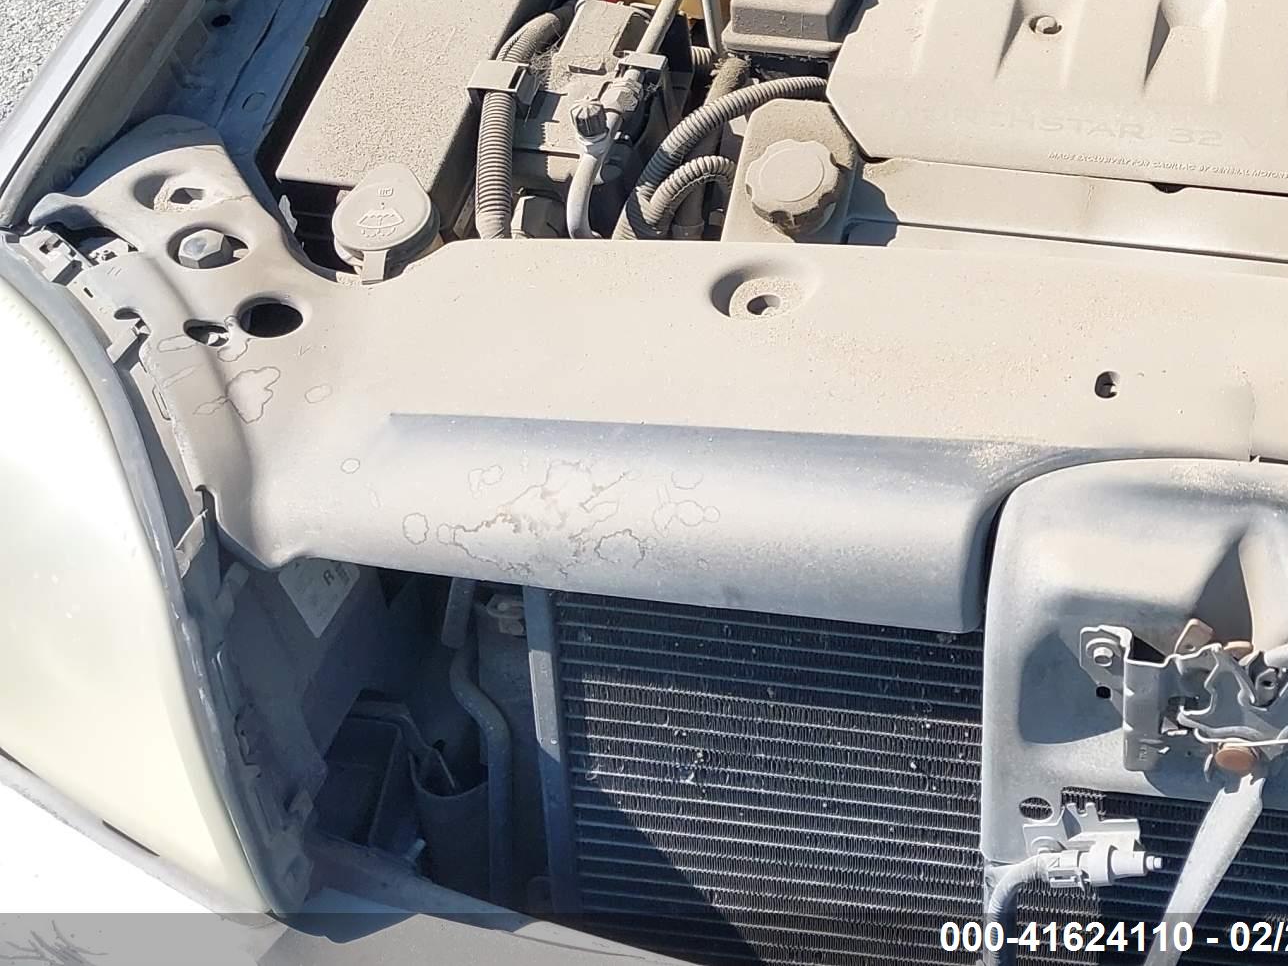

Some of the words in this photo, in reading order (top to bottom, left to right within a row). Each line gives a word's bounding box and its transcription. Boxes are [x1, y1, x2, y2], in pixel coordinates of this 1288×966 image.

[1167, 127, 1223, 147] 32
[1047, 151, 1076, 161] MADE
[1078, 152, 1131, 166] EXCLUSIVELY
[1131, 159, 1151, 168] FOR
[1152, 160, 1197, 172] CADILLAC
[1210, 165, 1251, 177] GENERAL
